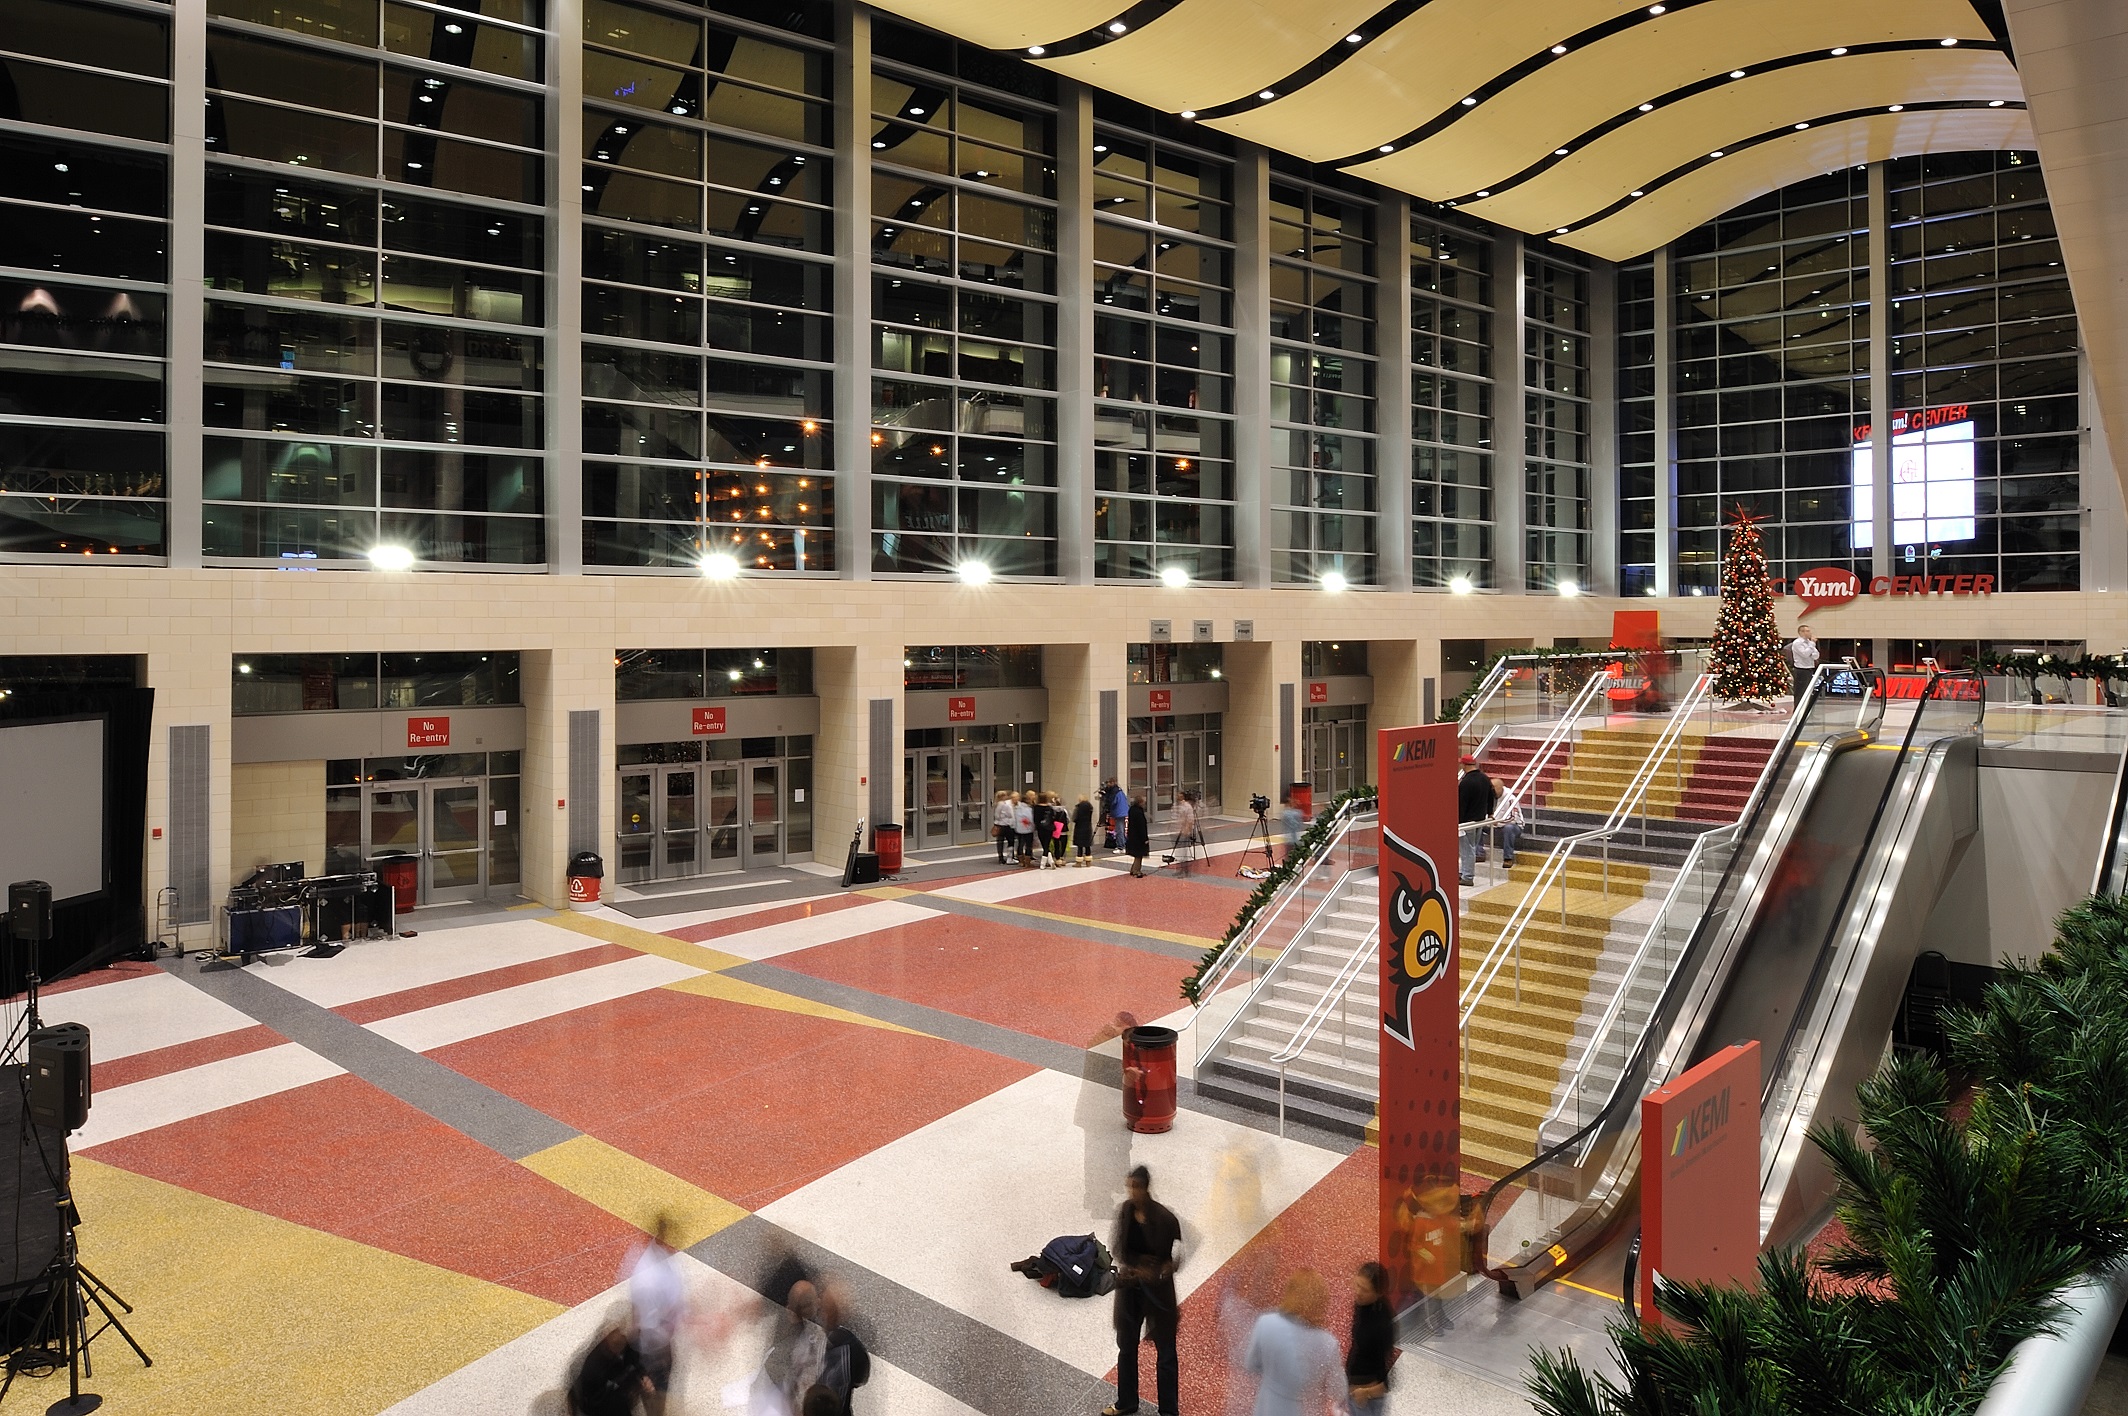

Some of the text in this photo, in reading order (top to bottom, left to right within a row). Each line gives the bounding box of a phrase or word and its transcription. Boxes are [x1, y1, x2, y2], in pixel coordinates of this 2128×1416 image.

[1912, 404, 1969, 430] CENTER
[1799, 576, 1855, 597] Yum!
[1869, 574, 1995, 597] CENTER
[958, 700, 966, 708] No
[704, 711, 714, 720] No
[423, 721, 435, 731] No
[693, 721, 724, 731] Re-entry
[410, 733, 448, 743] Re-entry
[1406, 739, 1436, 761] KEMI
[1689, 1086, 1730, 1149] KEMI
